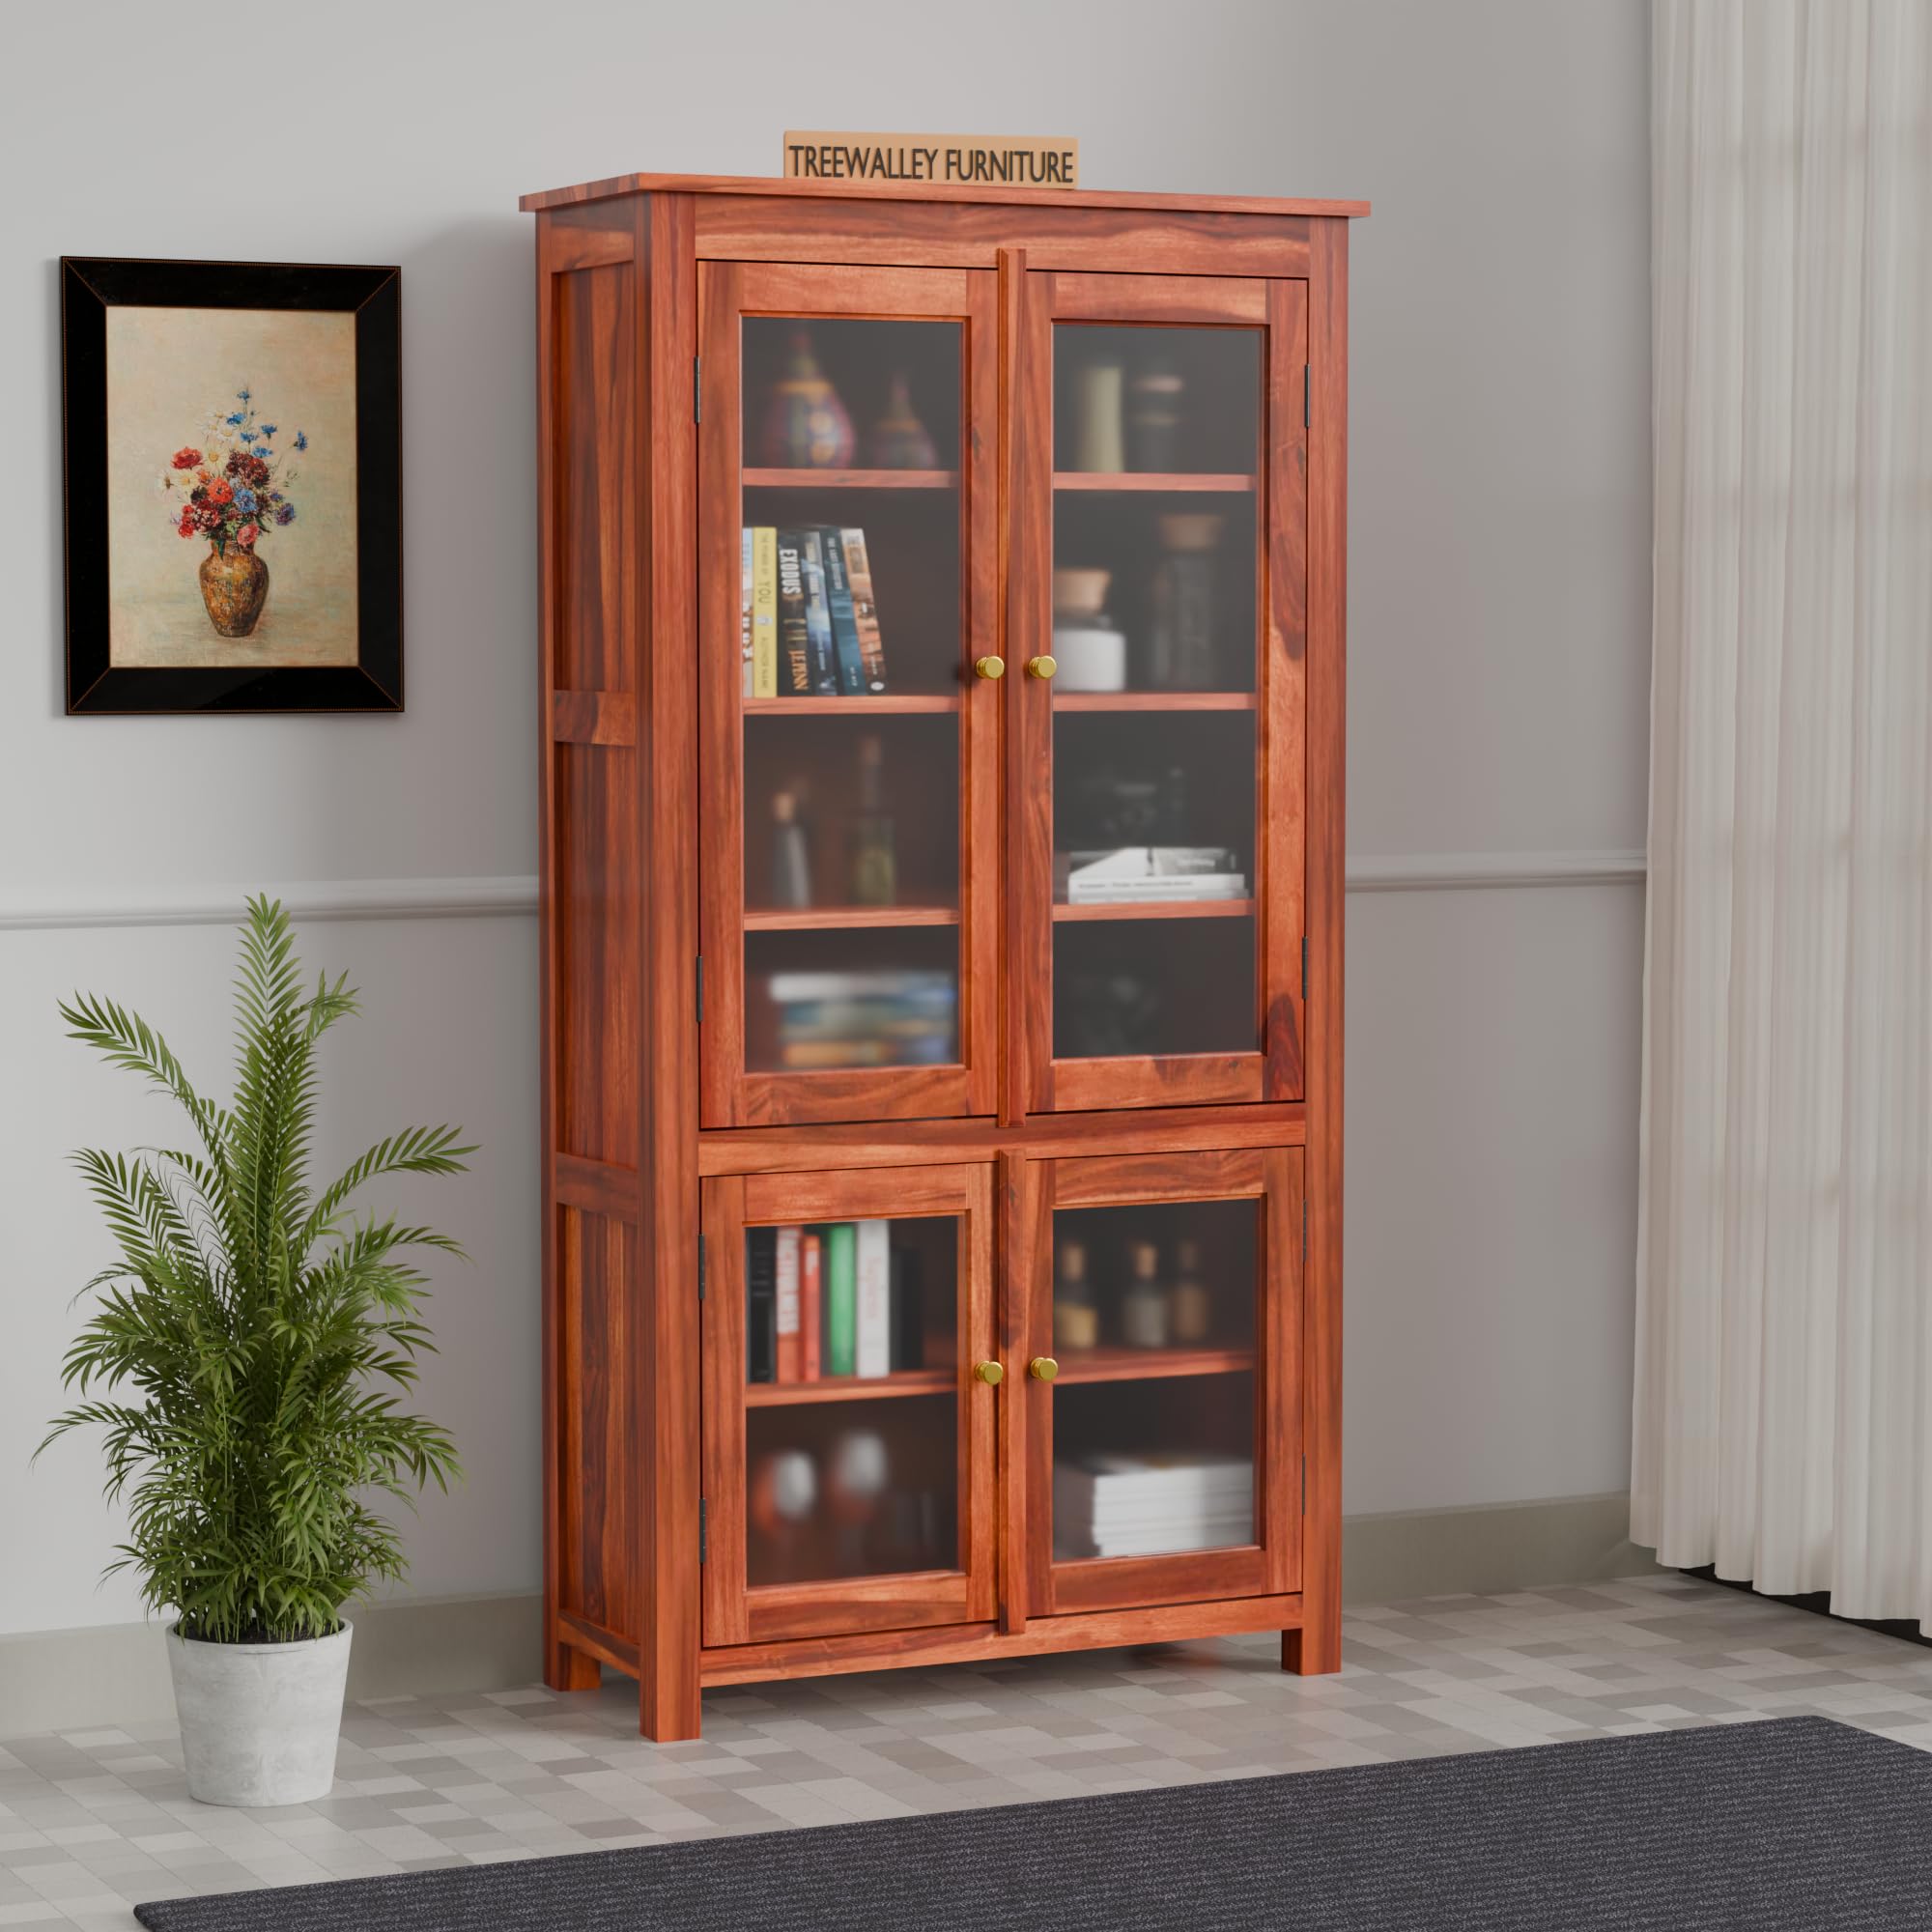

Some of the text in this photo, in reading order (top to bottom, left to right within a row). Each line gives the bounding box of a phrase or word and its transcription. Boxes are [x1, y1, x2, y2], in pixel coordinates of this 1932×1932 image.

[788, 145, 1074, 183] TREEWALLEY FURNITURE
[779, 548, 802, 594] EXODUS
[758, 581, 772, 604] YOU
